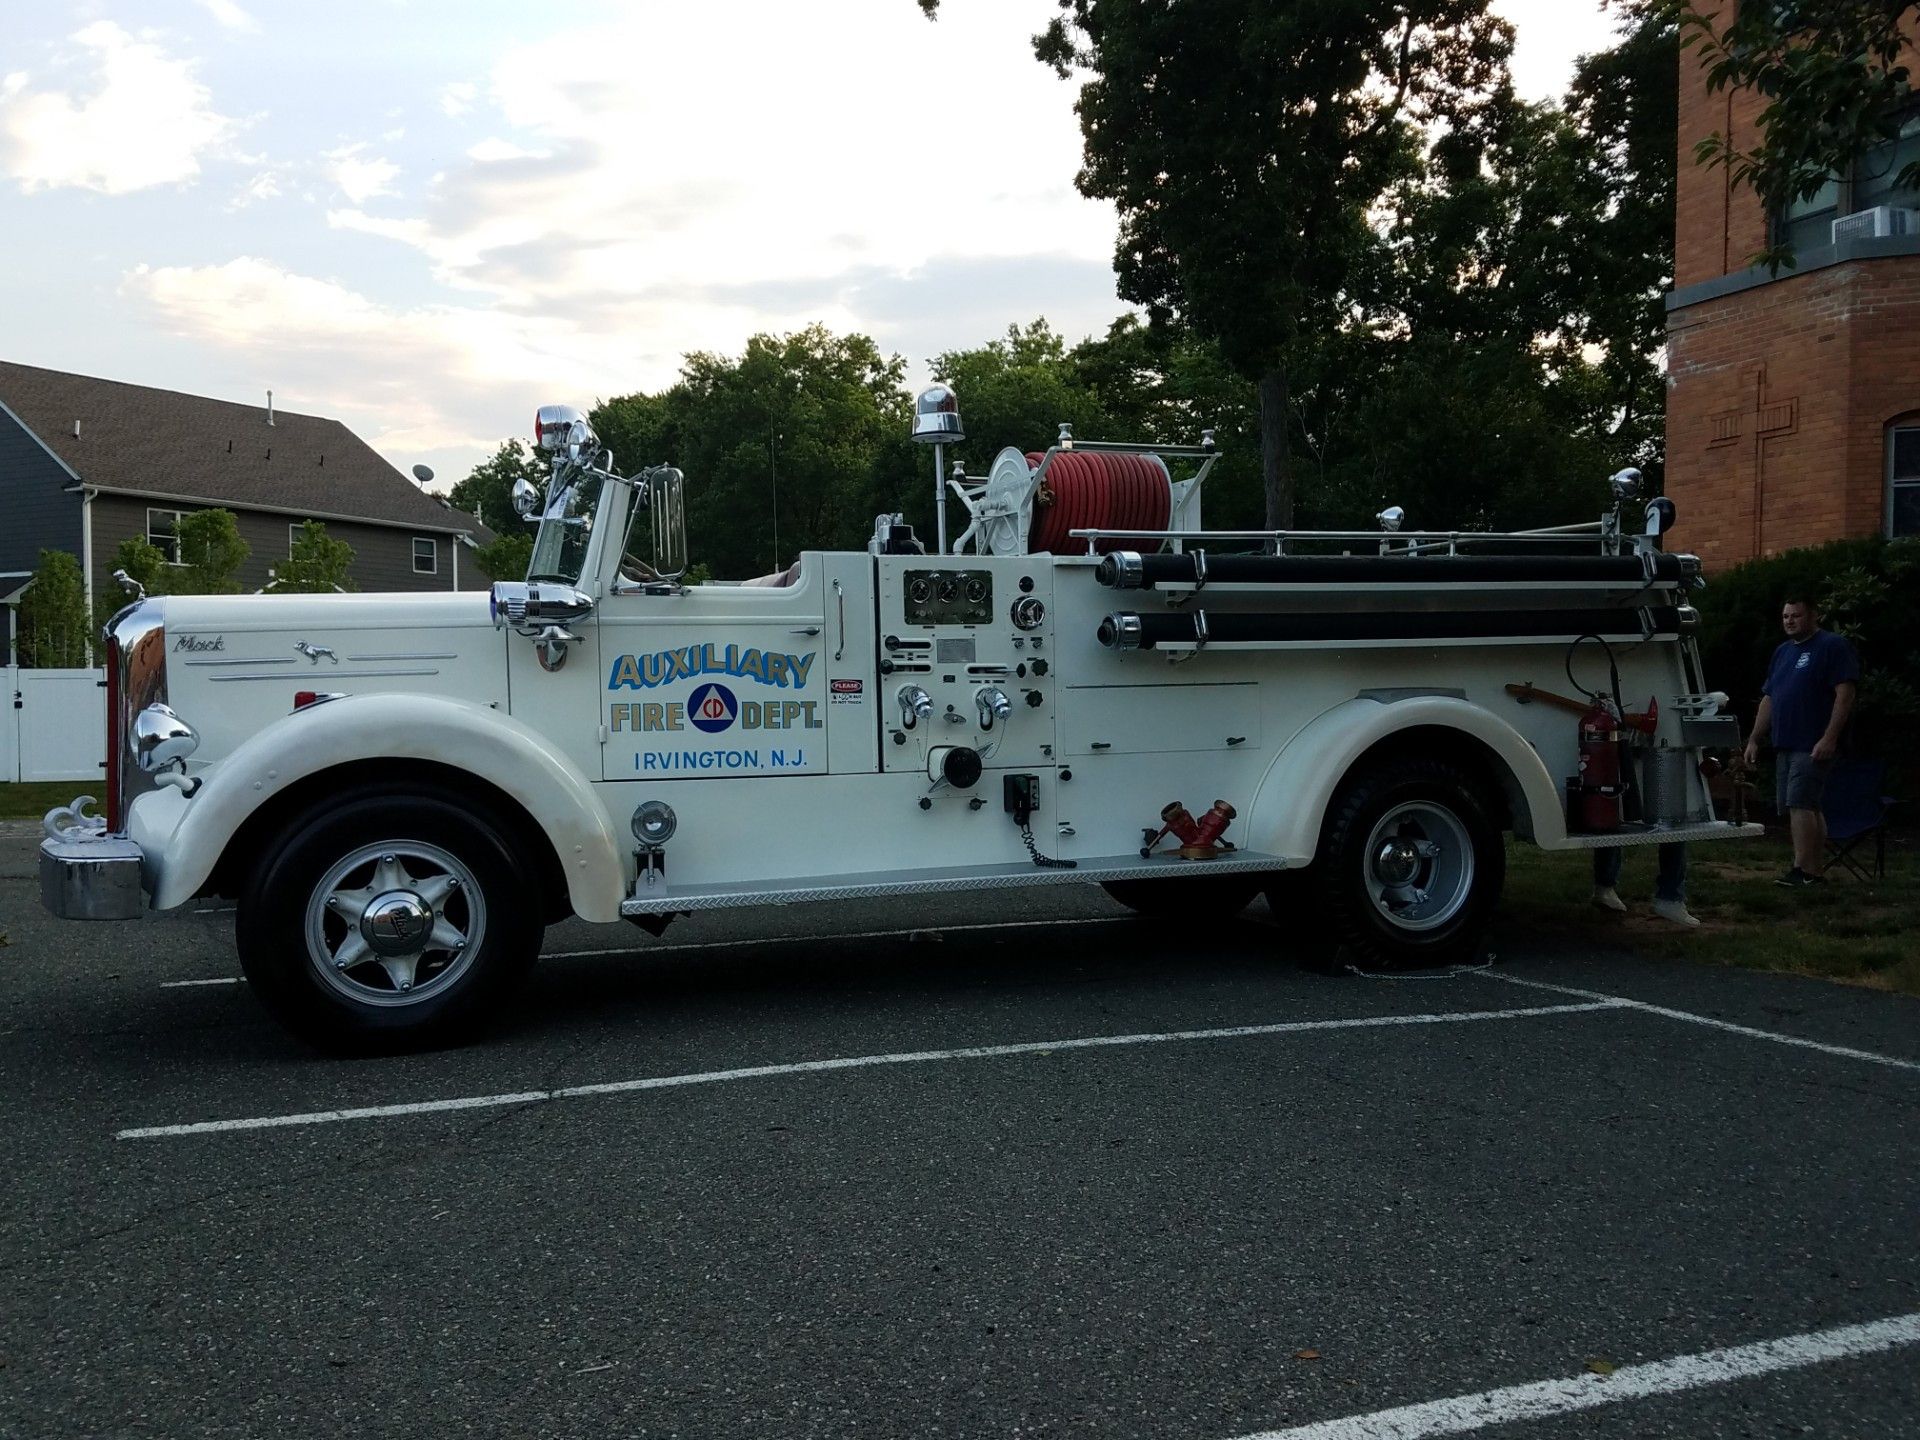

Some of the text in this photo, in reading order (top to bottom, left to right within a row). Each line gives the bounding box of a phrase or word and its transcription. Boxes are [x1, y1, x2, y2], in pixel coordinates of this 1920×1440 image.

[172, 634, 225, 652] Mack
[608, 643, 816, 690] AUXILIARY
[611, 699, 823, 732] FIRE CD DEPT.
[635, 751, 764, 770] IRVINGTON,
